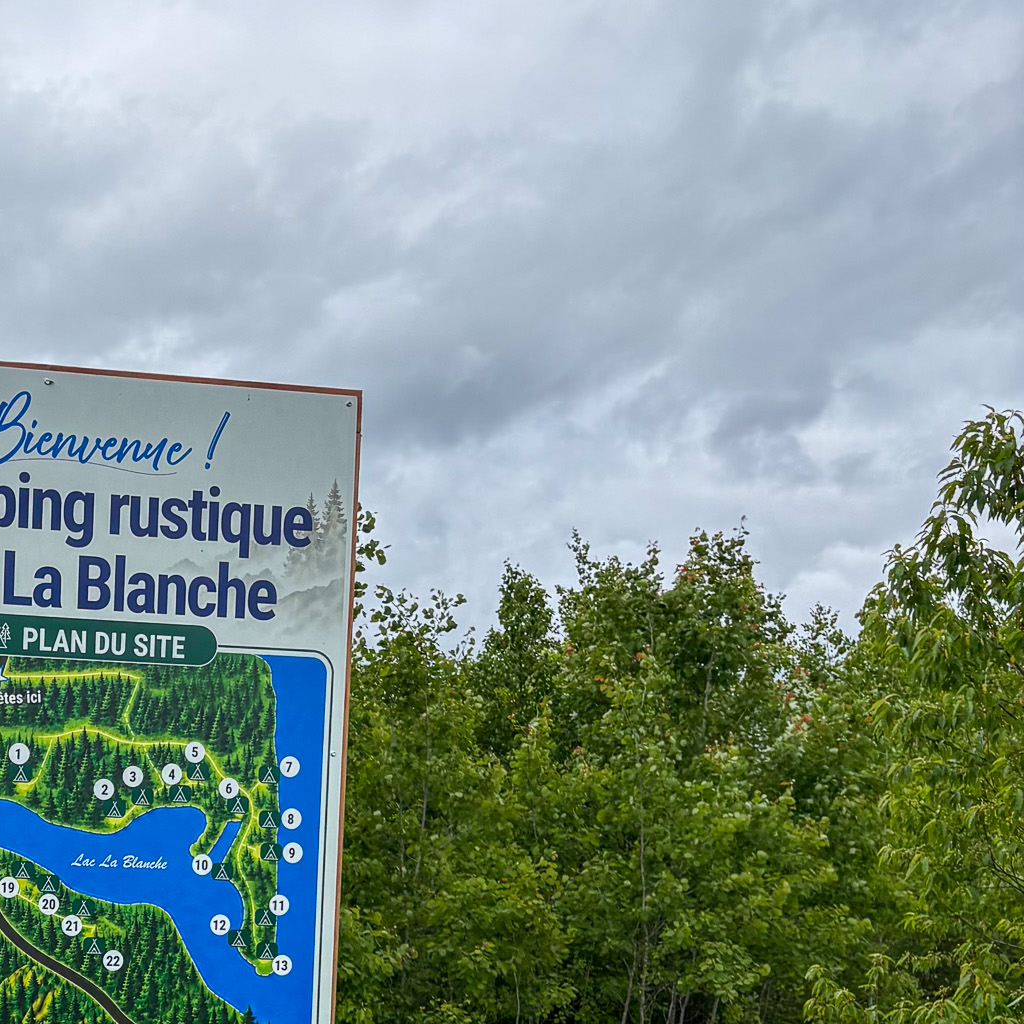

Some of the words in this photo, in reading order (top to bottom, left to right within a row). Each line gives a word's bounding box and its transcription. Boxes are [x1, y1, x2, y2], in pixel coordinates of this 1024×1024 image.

[109, 485, 313, 559] rustique
[3, 550, 62, 608] La
[77, 555, 277, 621] Blanche
[22, 627, 87, 654] PLAN
[95, 632, 126, 656] DU
[133, 633, 185, 659] SITE
[27, 690, 41, 704] ici
[71, 853, 95, 866] Lac
[99, 854, 118, 868] La
[123, 855, 167, 870] Blanche
